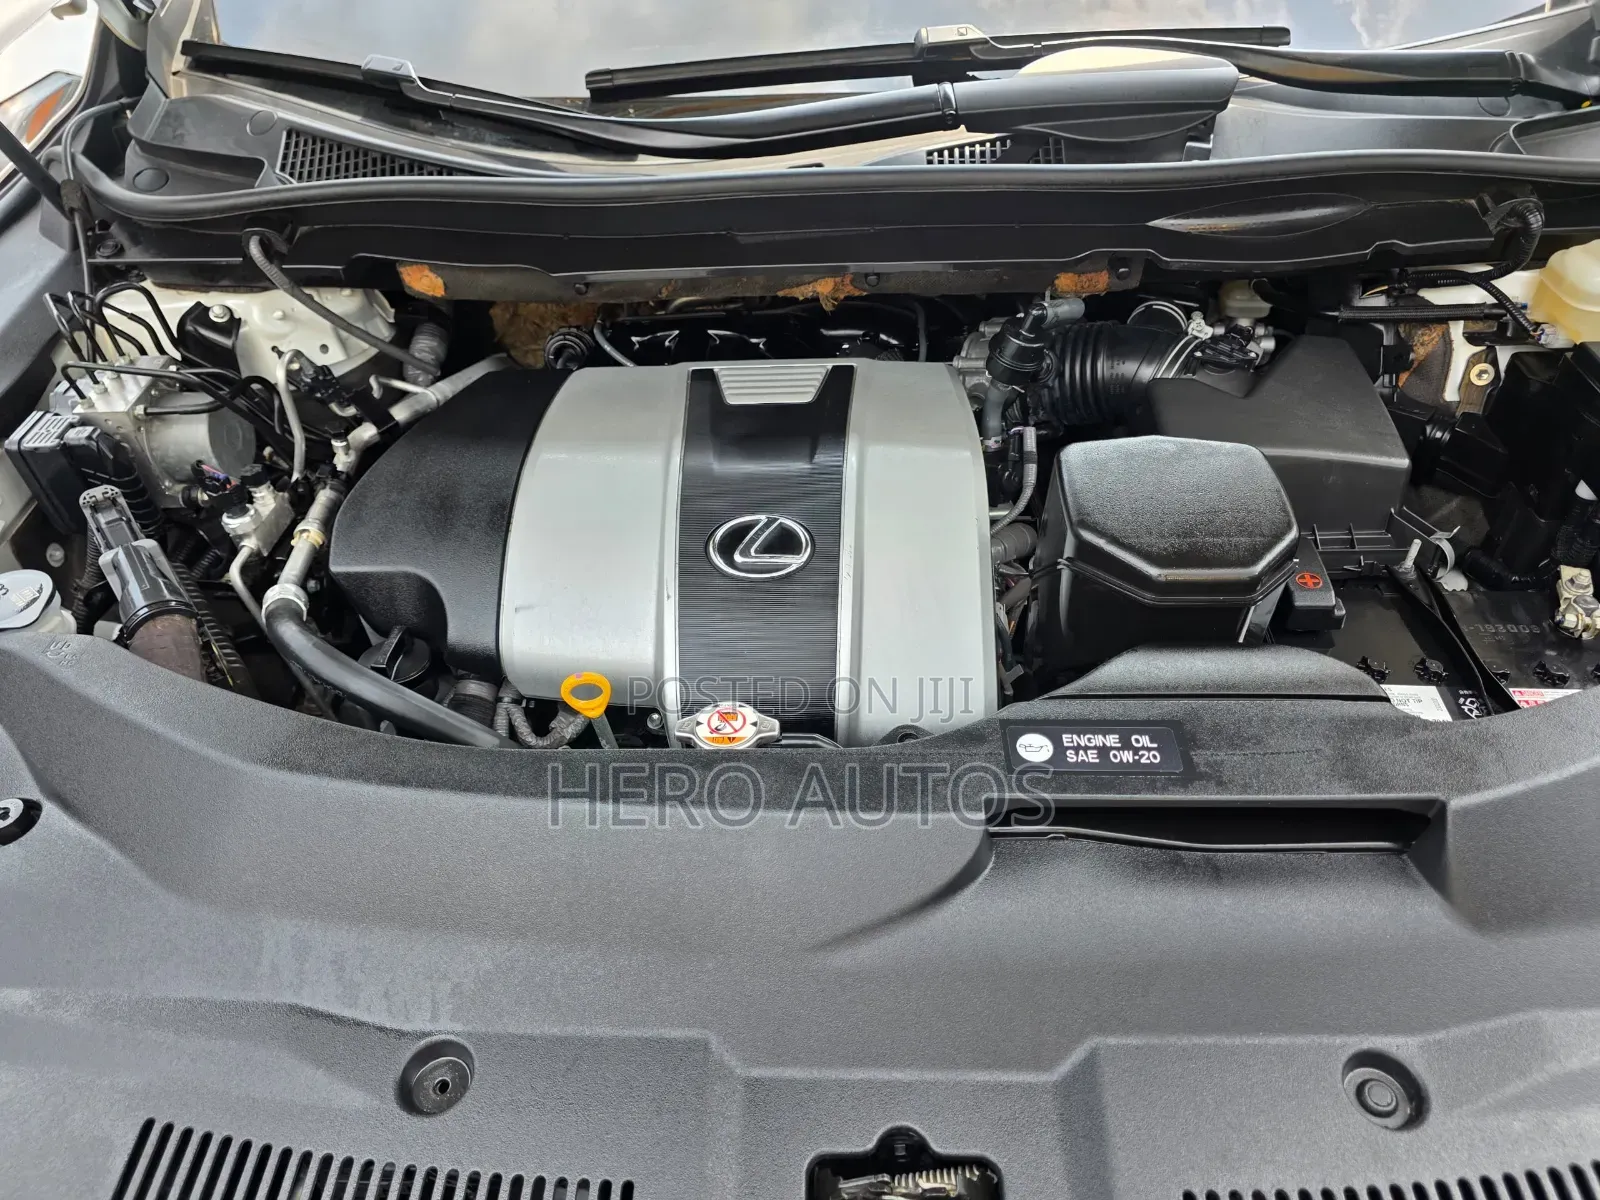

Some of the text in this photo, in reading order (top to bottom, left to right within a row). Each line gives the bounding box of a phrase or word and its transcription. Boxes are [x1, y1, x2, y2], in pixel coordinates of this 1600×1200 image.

[1062, 734, 1158, 748] ENGINE OIL
[1066, 750, 1161, 764] SAE 0W-20
